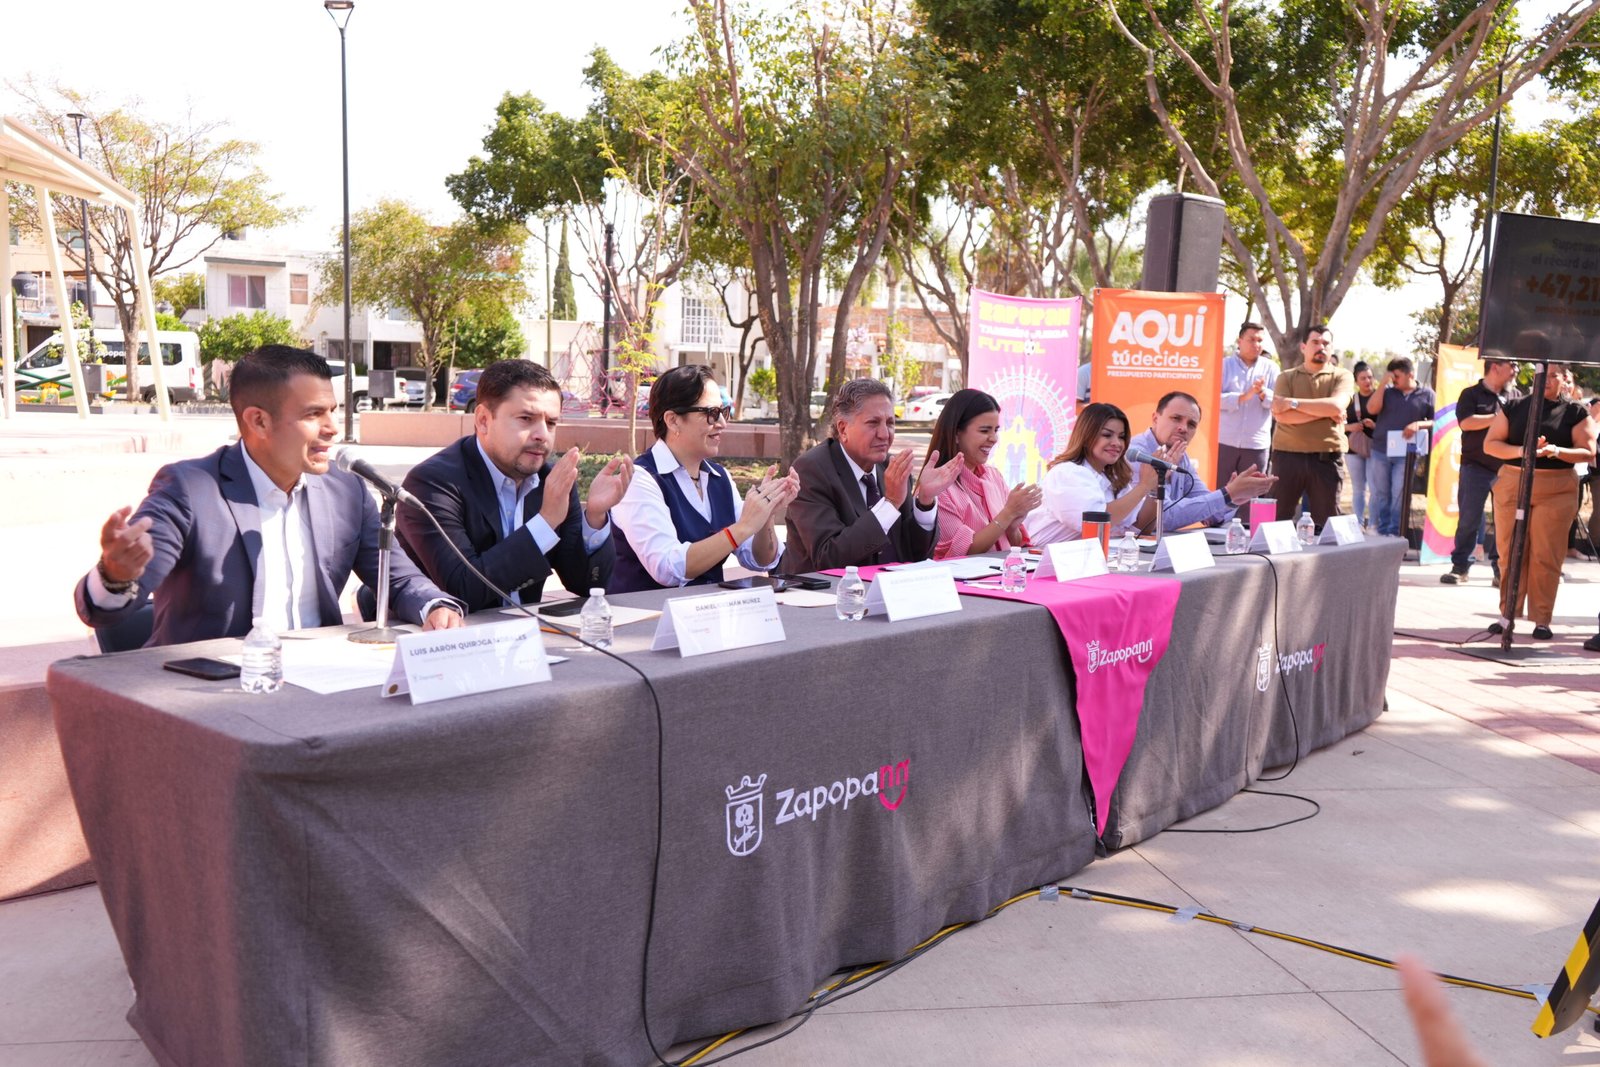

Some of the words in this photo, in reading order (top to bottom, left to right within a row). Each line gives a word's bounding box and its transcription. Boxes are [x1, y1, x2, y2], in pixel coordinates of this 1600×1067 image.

[1108, 305, 1208, 354] AQUÍ
[1107, 370, 1152, 378] PRESUPUESTO
[1153, 371, 1202, 380] PARTICIPATIVO
[410, 648, 427, 656] LUIS
